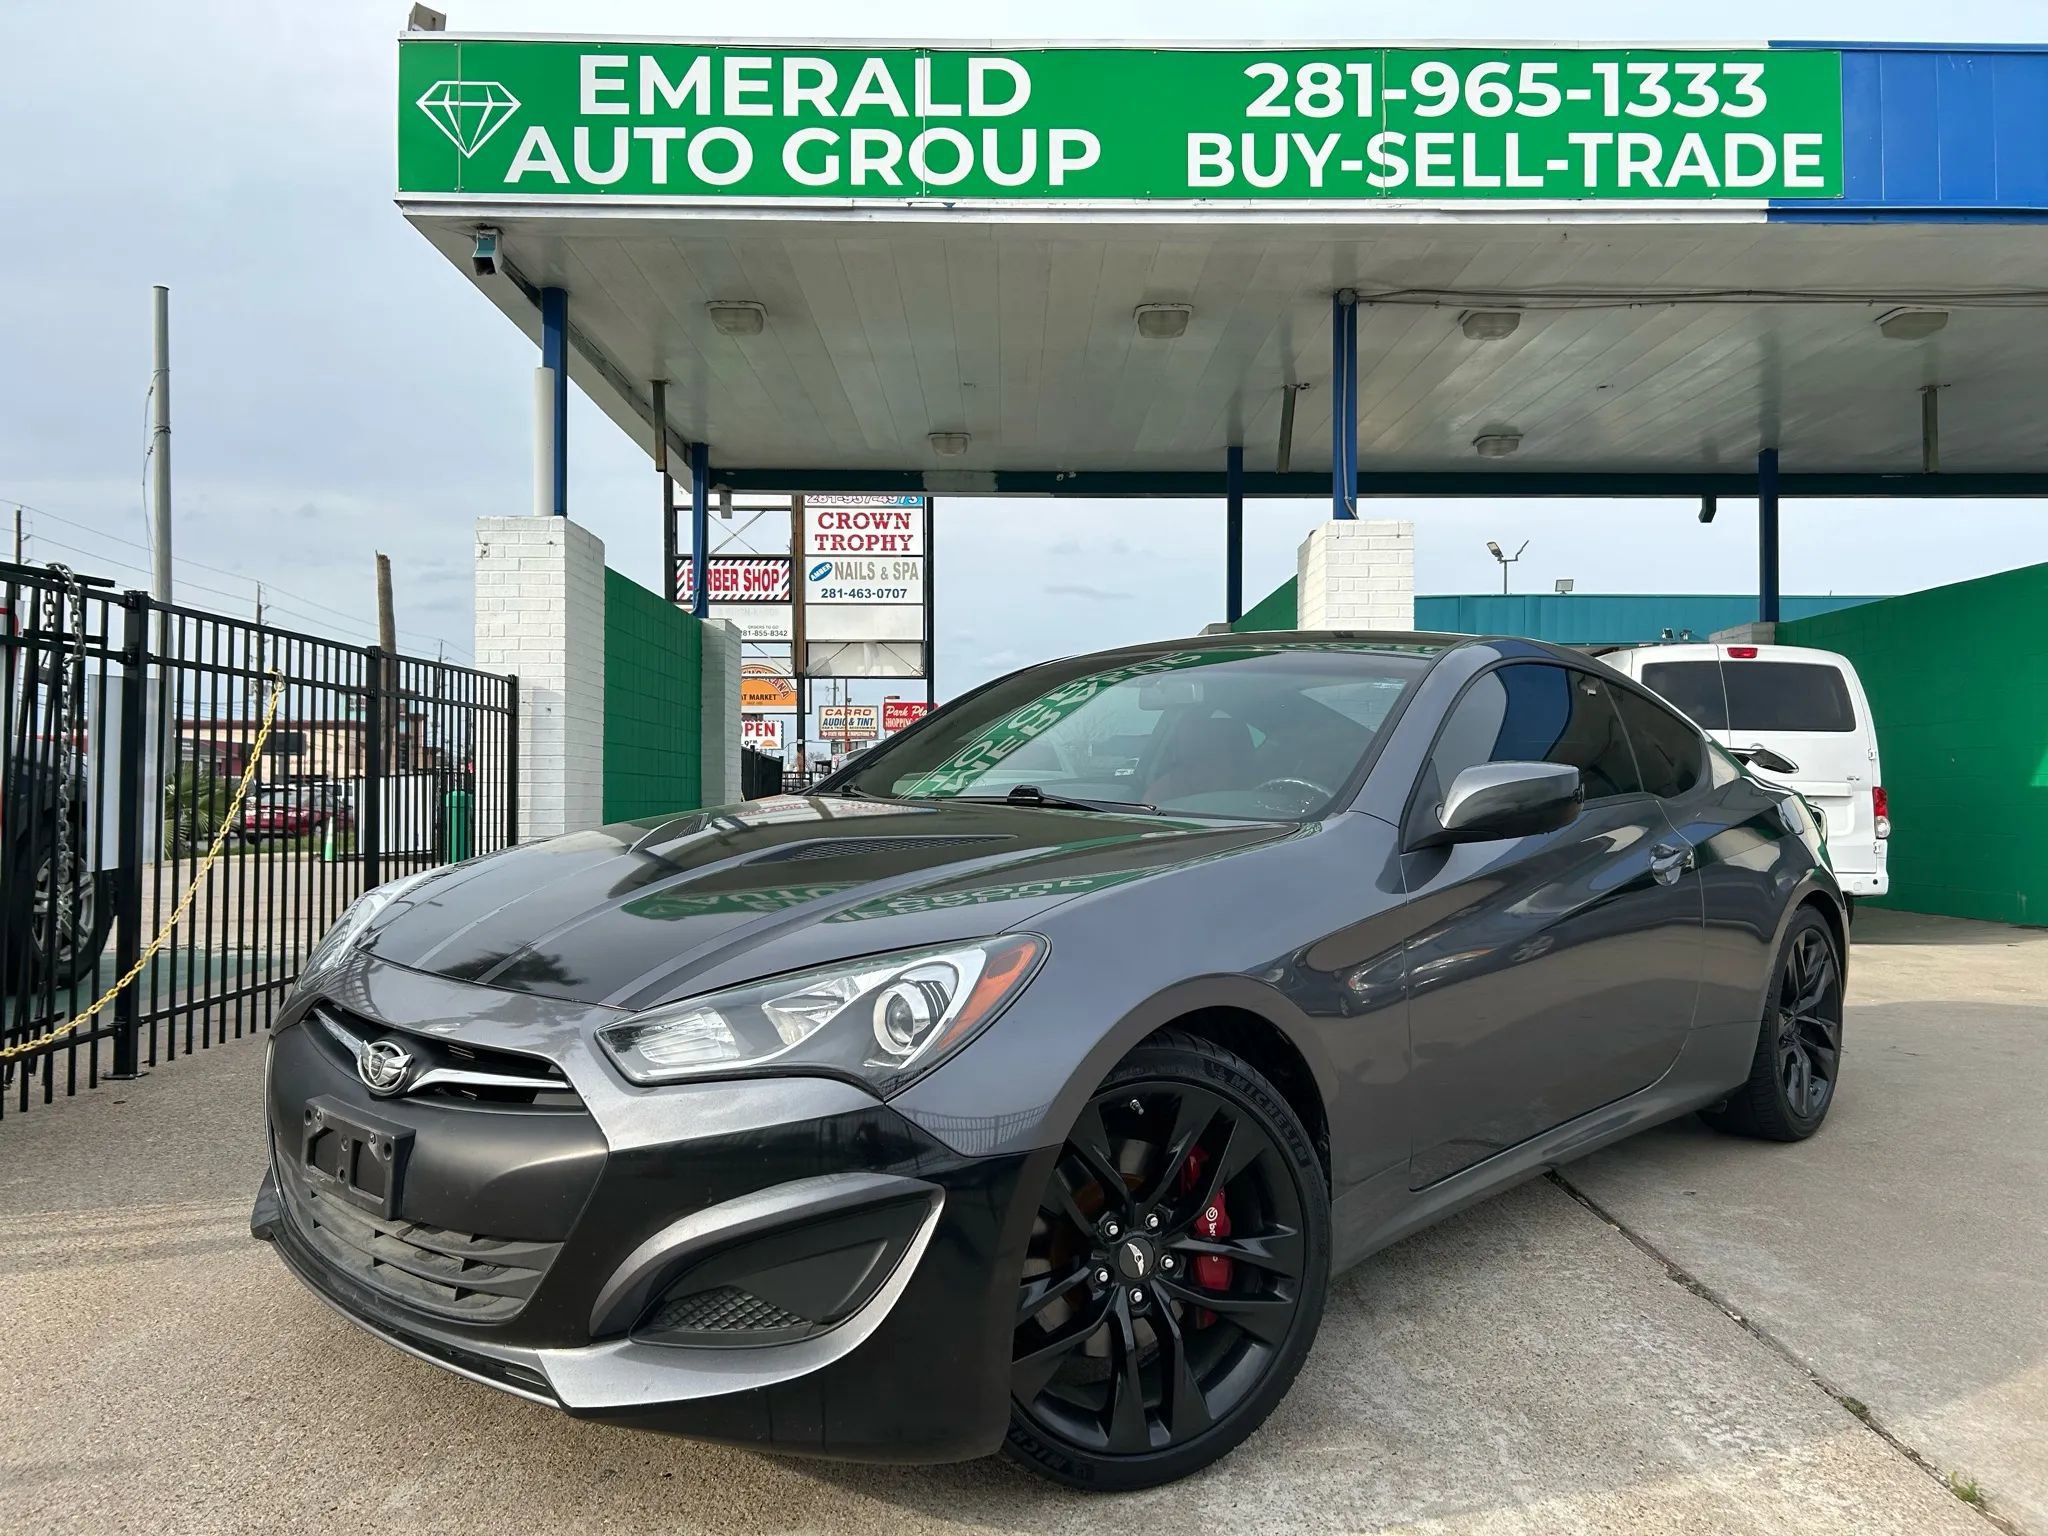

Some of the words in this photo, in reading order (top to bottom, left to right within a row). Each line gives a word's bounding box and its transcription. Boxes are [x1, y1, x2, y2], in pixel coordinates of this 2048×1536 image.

[582, 56, 1031, 117] EMERALD
[1247, 63, 1767, 118] 281-965-1333
[506, 128, 753, 186] AUTO
[784, 129, 1101, 186] GROUP
[1189, 133, 1824, 188] BUY-SELL-TRADE
[818, 512, 912, 530] CROWN
[815, 534, 914, 551] TROPHY
[687, 568, 739, 591] BRBER
[743, 568, 780, 592] SHOP
[835, 562, 876, 581] NAILS
[881, 566, 888, 580] &
[893, 562, 919, 581] SPA
[821, 588, 908, 599] 281-463-0707
[825, 708, 872, 716] CARRO
[885, 705, 909, 717] Park
[911, 705, 928, 717] Pla
[741, 723, 775, 737] PEN
[822, 718, 847, 726] AUDIO
[848, 718, 855, 726] &
[857, 718, 874, 726] TINT
[885, 718, 913, 728] SHOPPIN
